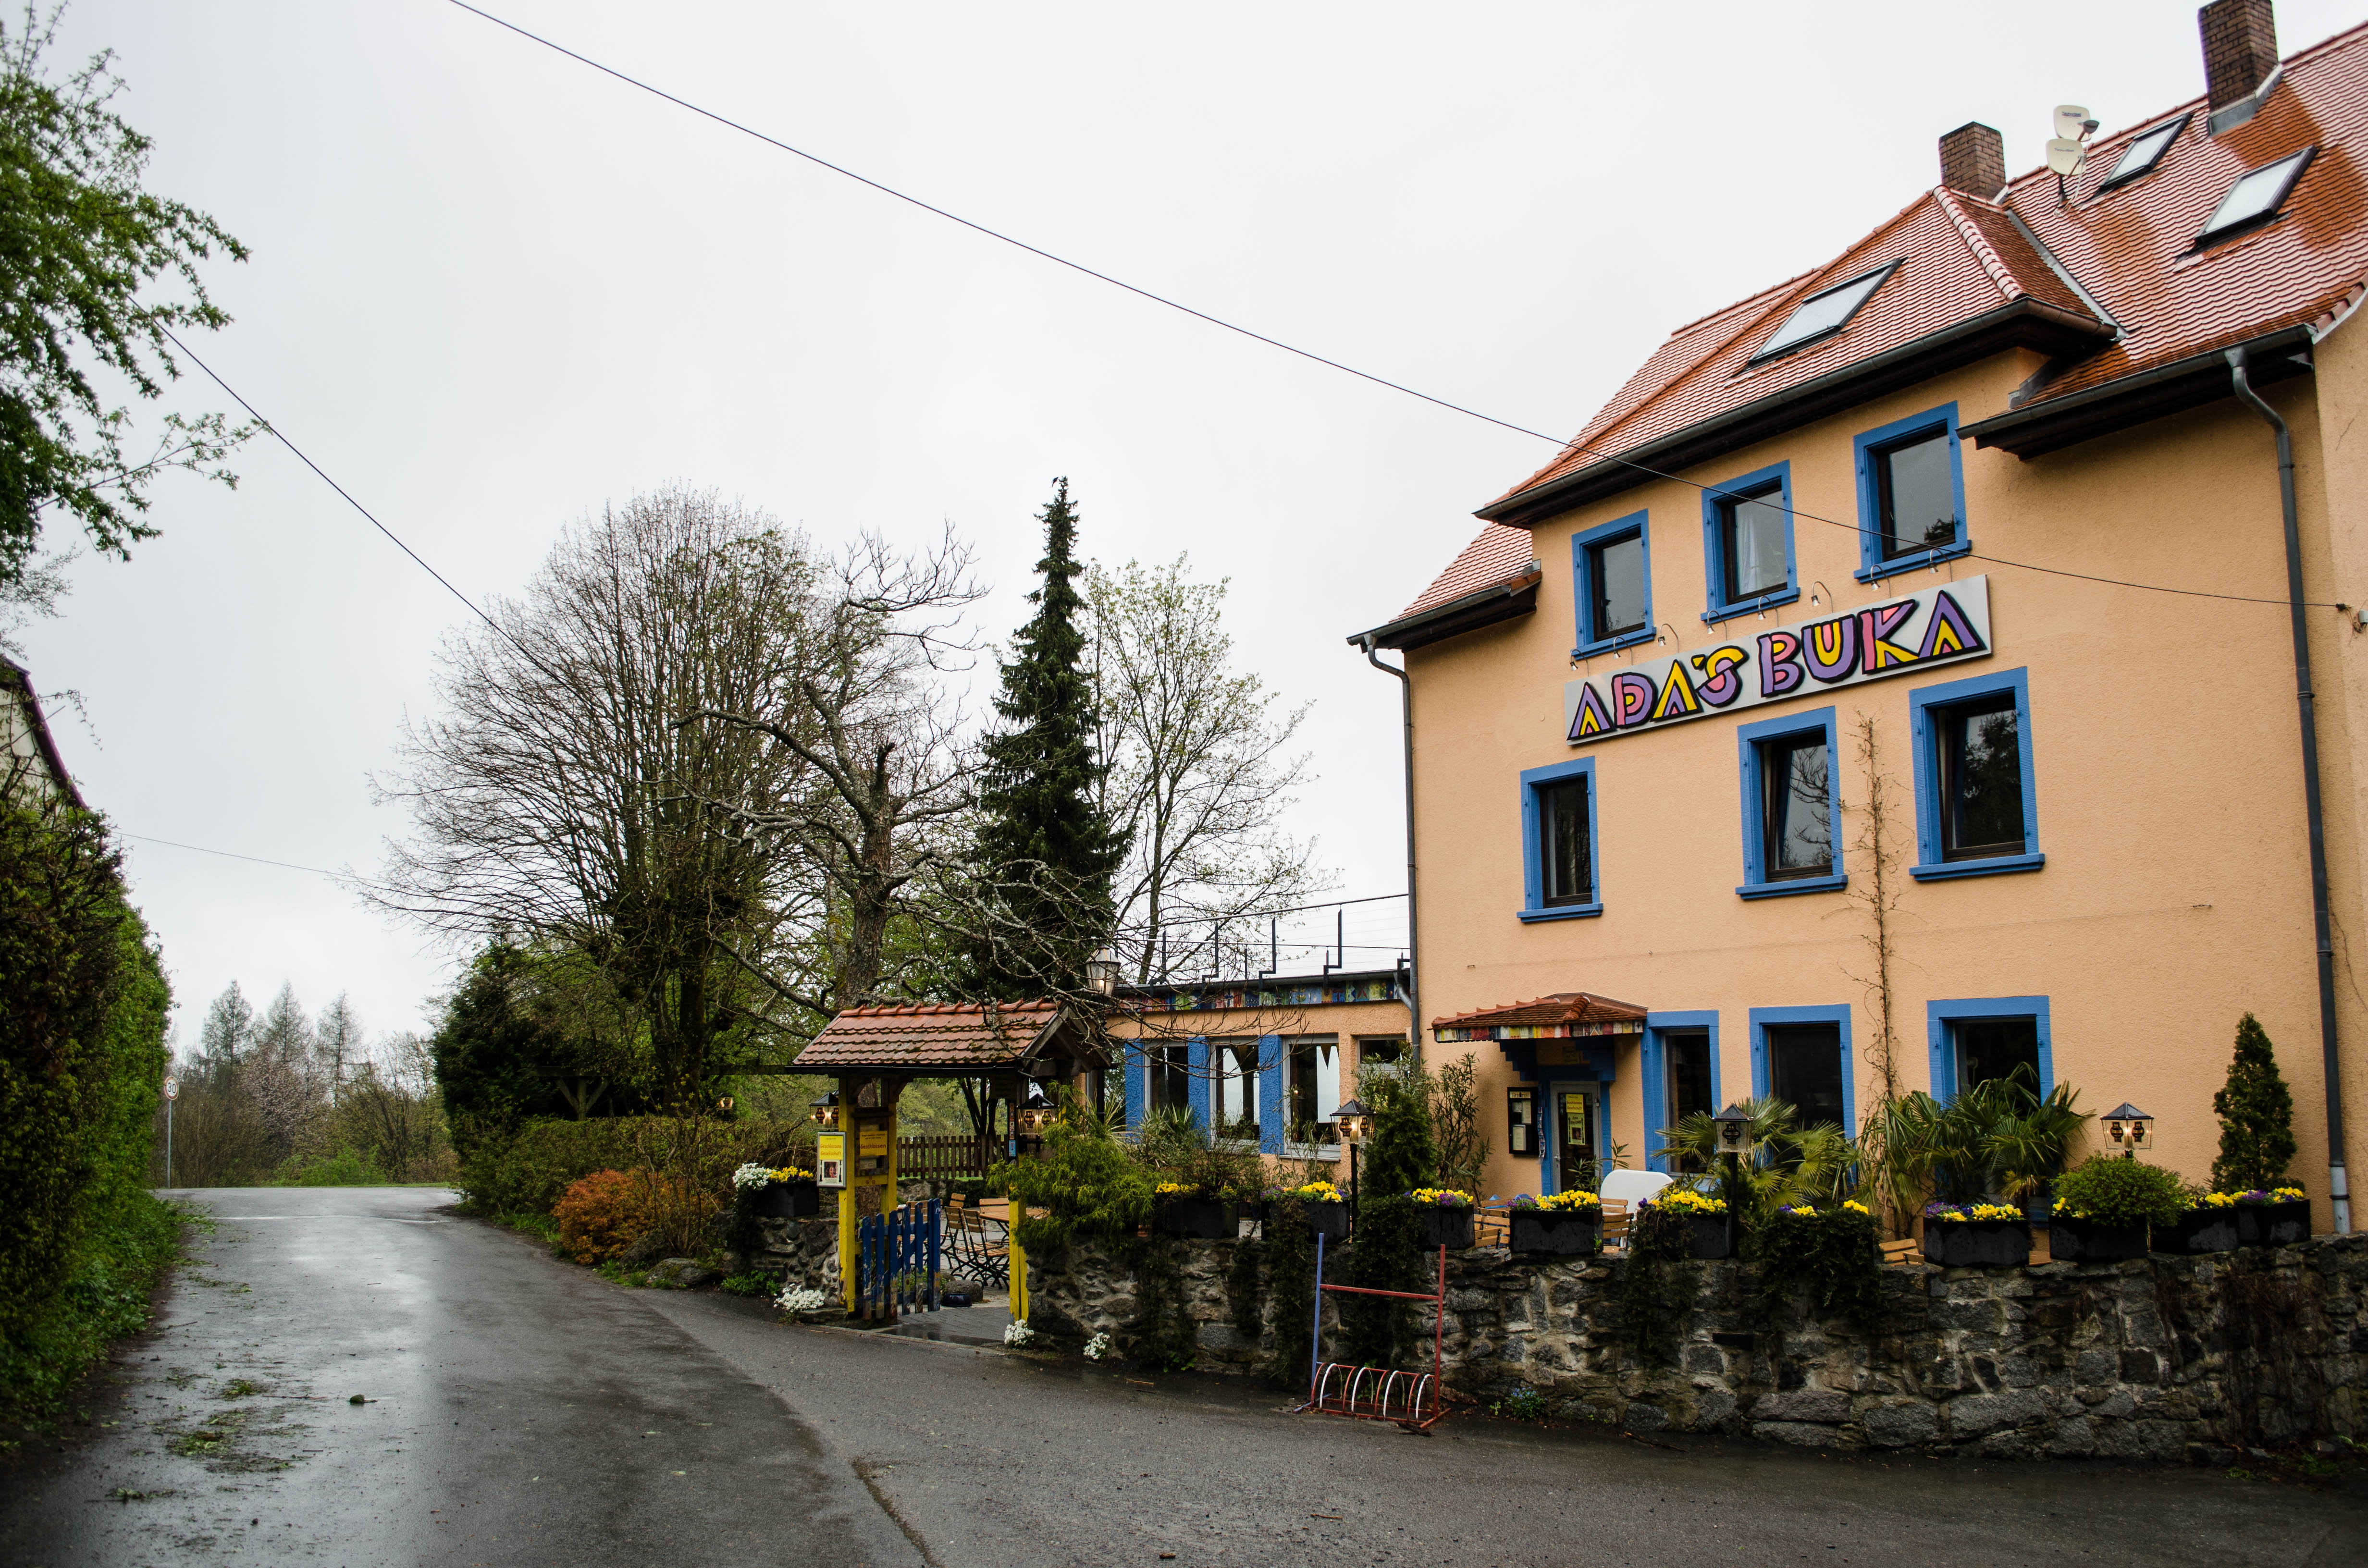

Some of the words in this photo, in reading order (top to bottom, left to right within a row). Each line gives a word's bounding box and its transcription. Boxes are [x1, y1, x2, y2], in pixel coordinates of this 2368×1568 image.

[1567, 645, 1748, 741] ADA'S
[1757, 589, 1986, 698] BUKA
[168, 1082, 176, 1093] 30
